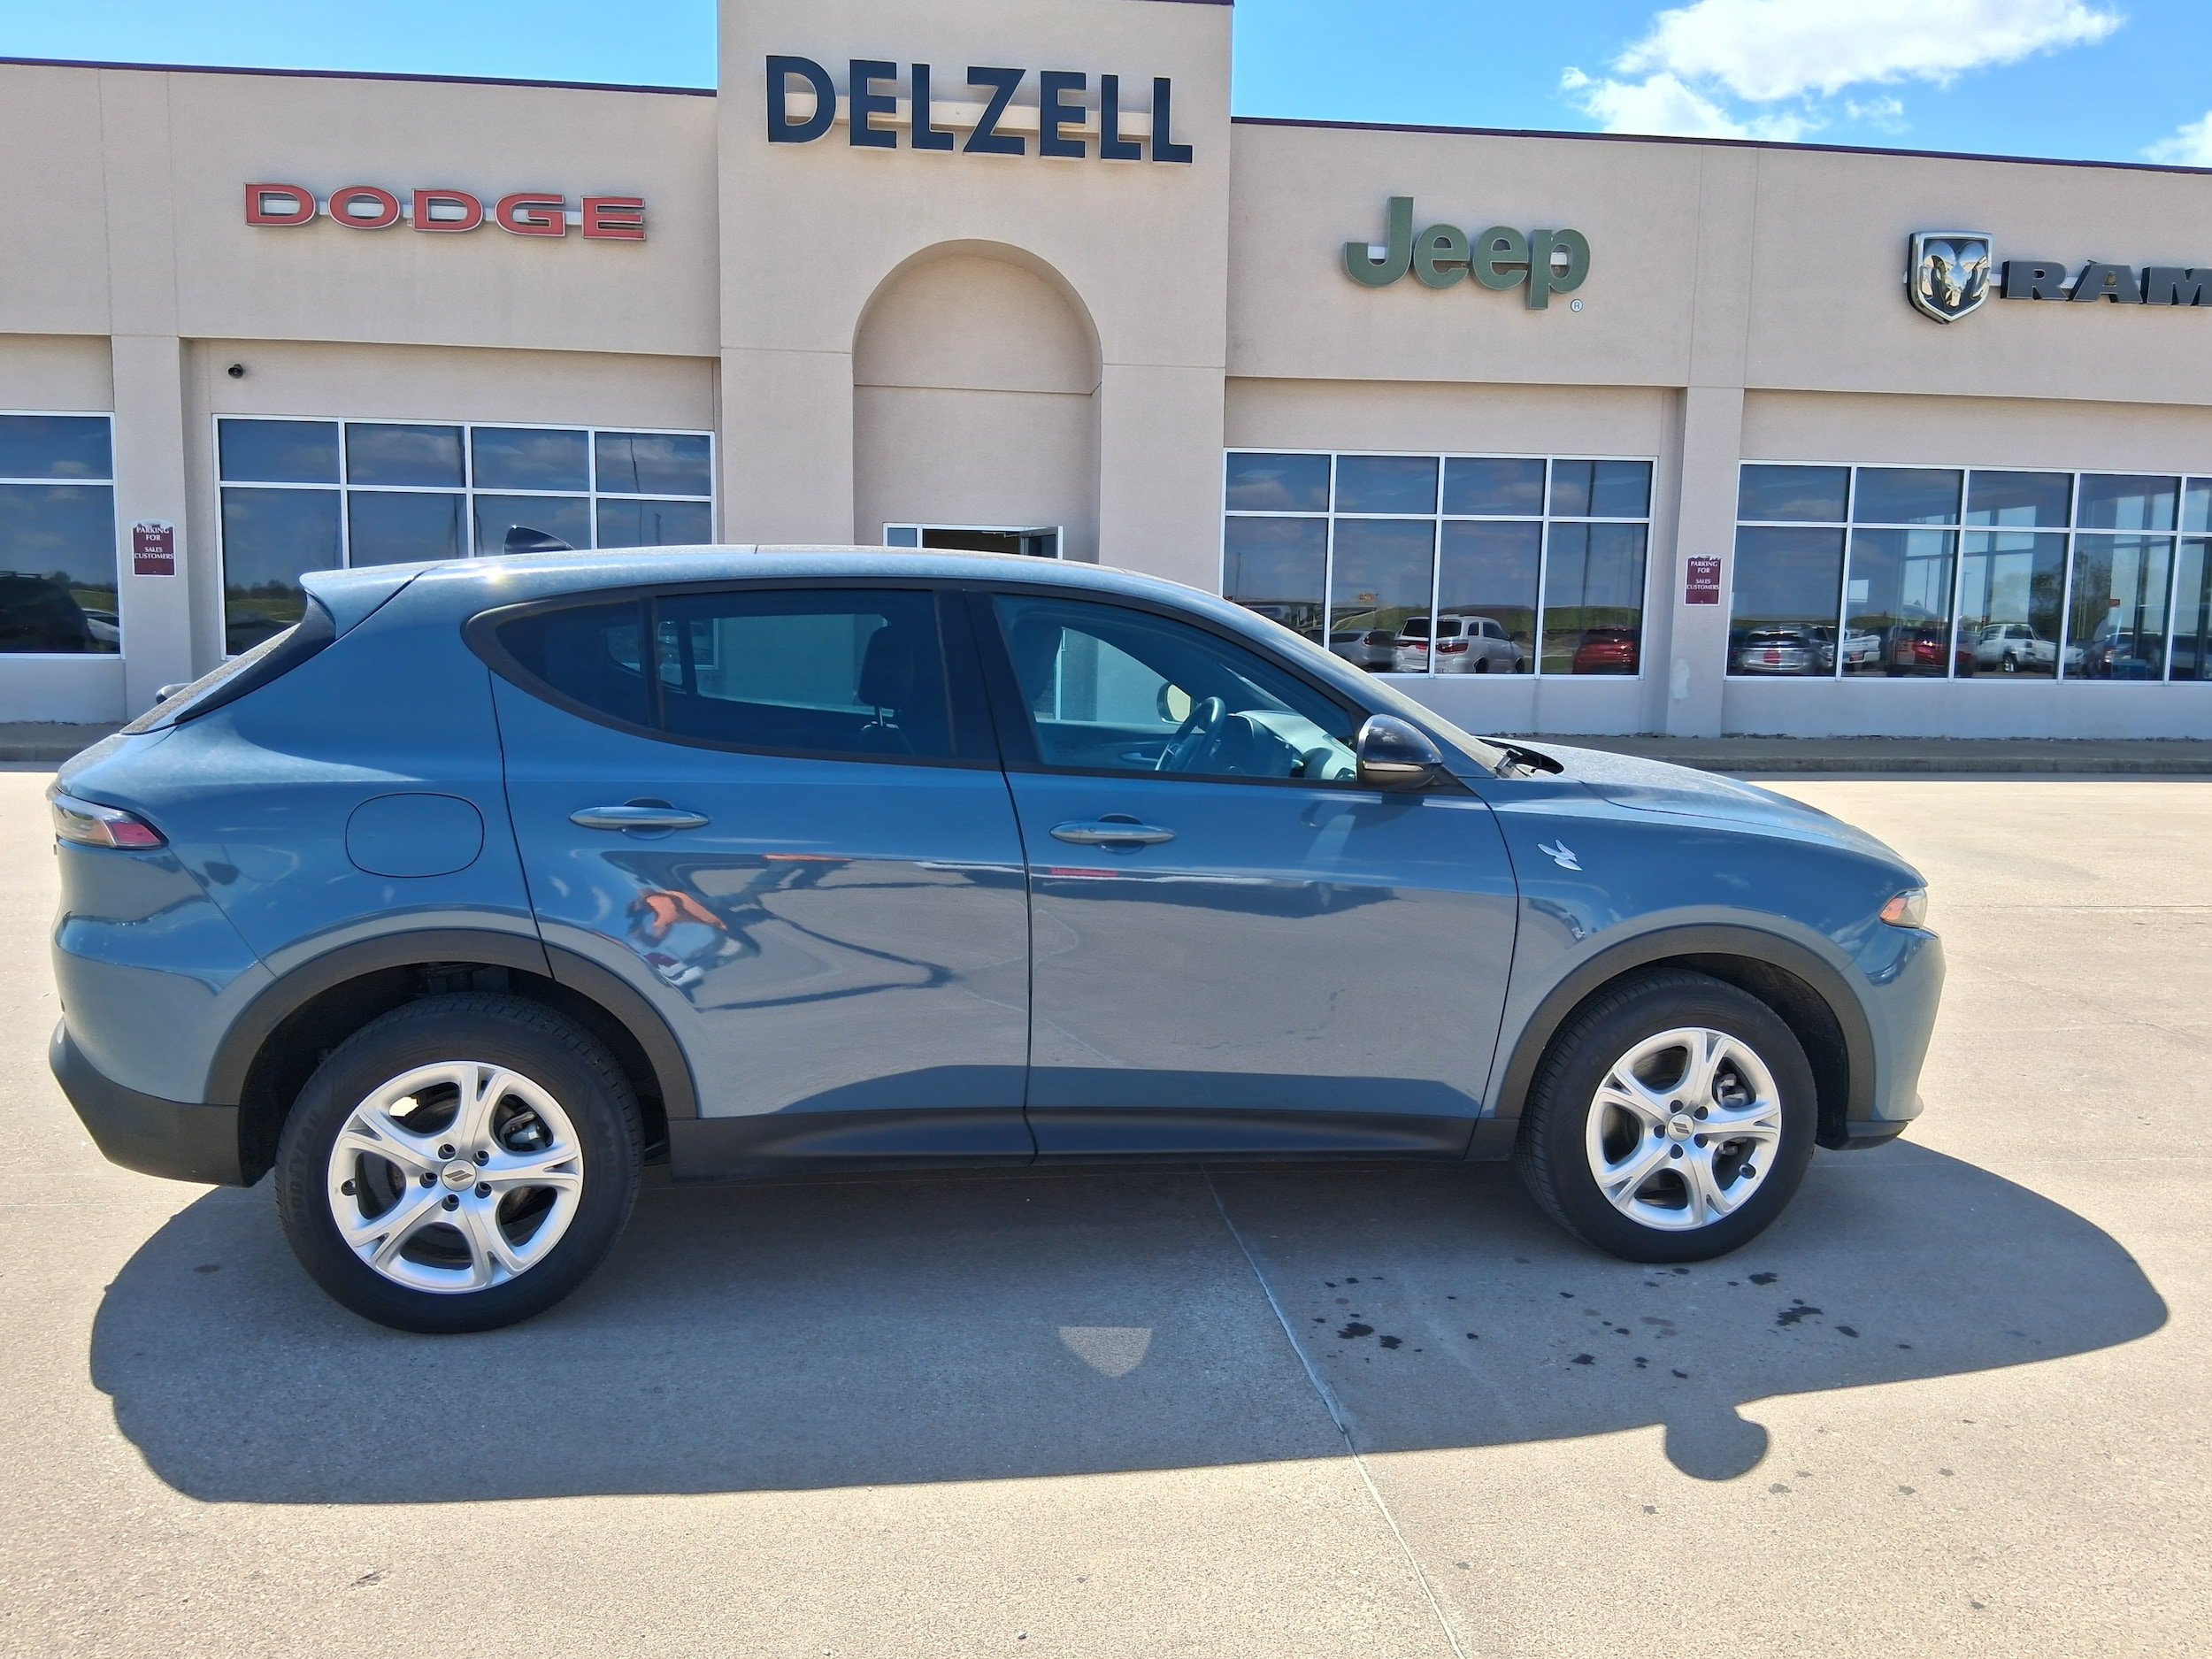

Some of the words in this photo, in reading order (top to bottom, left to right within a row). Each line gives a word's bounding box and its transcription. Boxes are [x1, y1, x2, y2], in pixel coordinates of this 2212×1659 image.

[765, 54, 1194, 165] DELZELL
[243, 181, 647, 242] DODGE
[1342, 195, 1591, 310] Jeep
[2000, 259, 2212, 306] RAM
